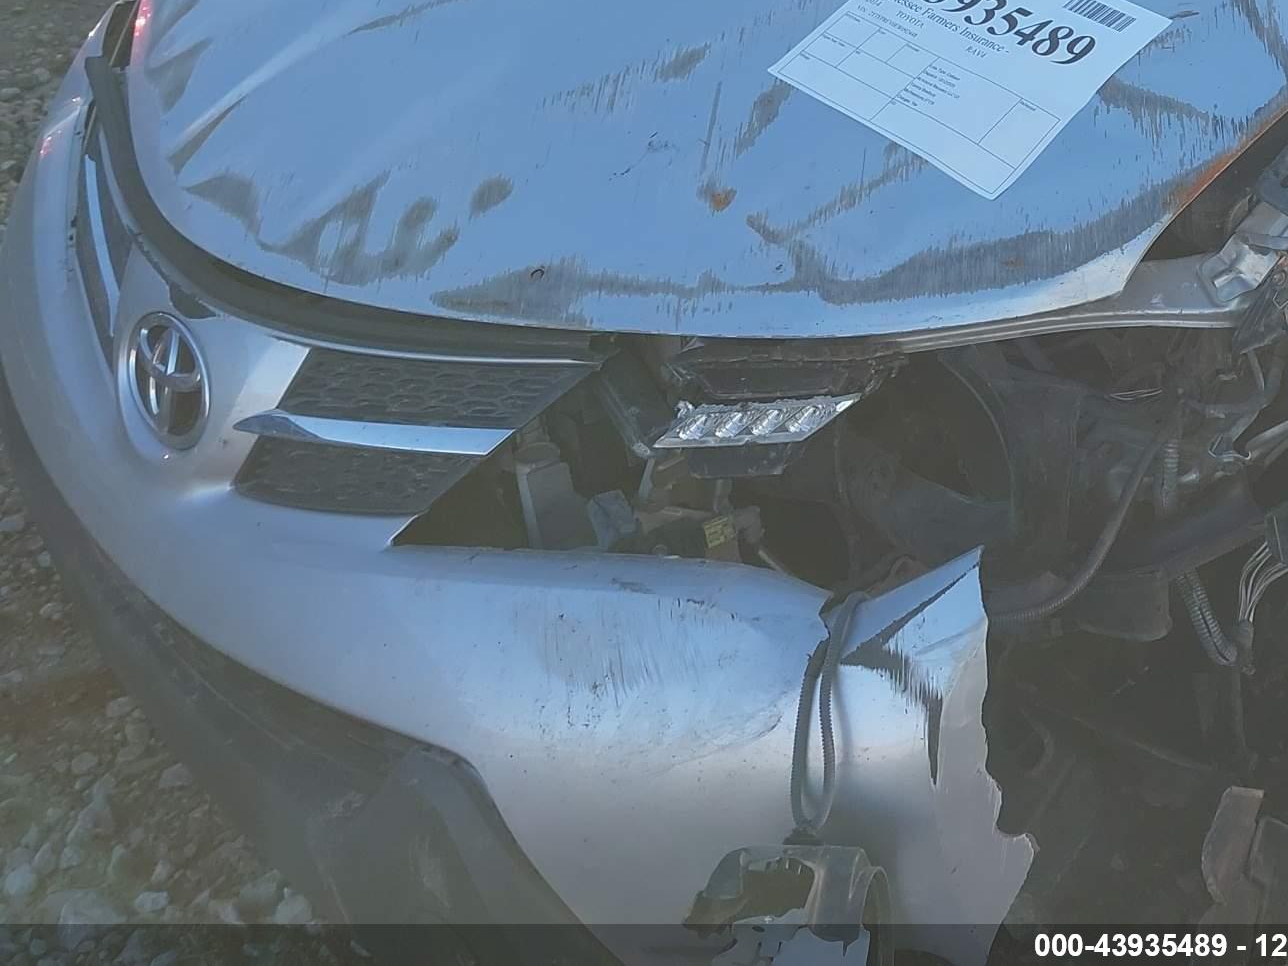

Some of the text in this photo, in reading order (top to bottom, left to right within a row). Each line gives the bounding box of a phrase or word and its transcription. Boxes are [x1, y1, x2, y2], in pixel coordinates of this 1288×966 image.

[895, 10, 925, 28] TOYOTA
[922, 7, 961, 32] Farmers
[959, 26, 1005, 52] Insurance
